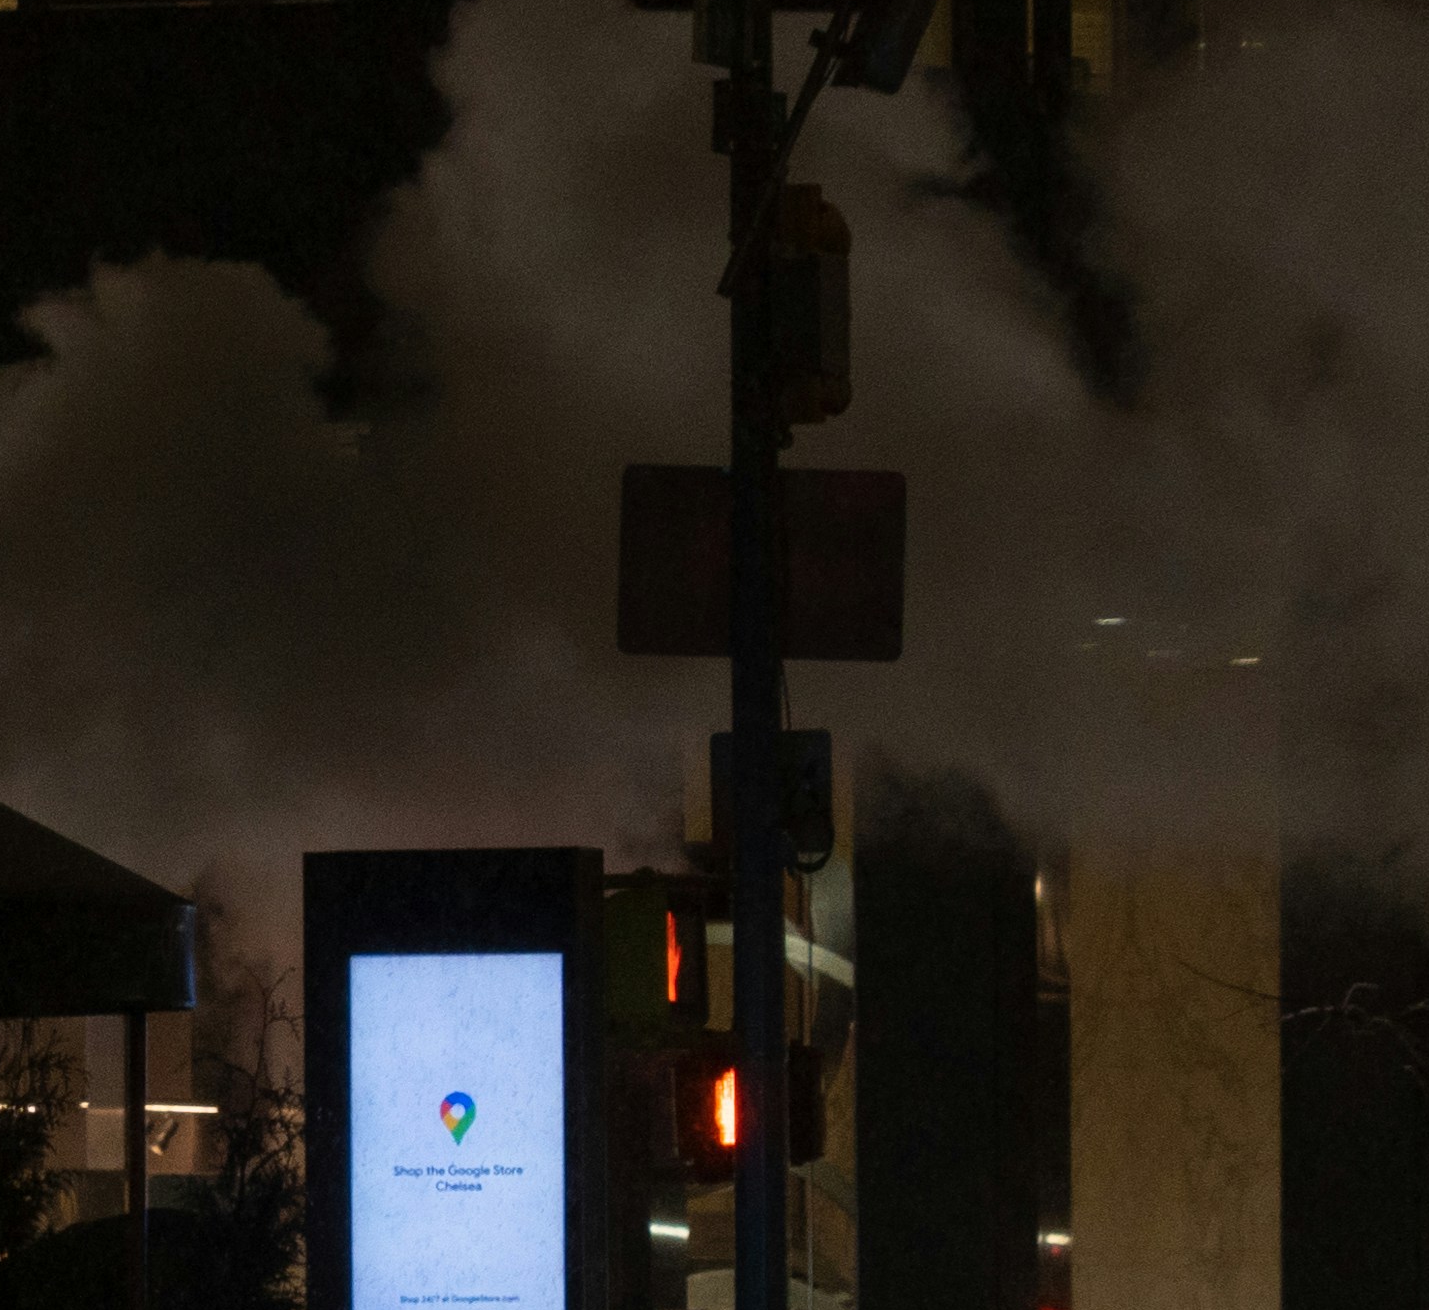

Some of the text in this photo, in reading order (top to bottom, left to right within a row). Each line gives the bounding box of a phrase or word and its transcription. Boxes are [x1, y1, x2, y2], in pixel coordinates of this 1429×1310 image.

[394, 1163, 523, 1178] Shop the Google Store
[435, 1180, 482, 1192] Chelsea
